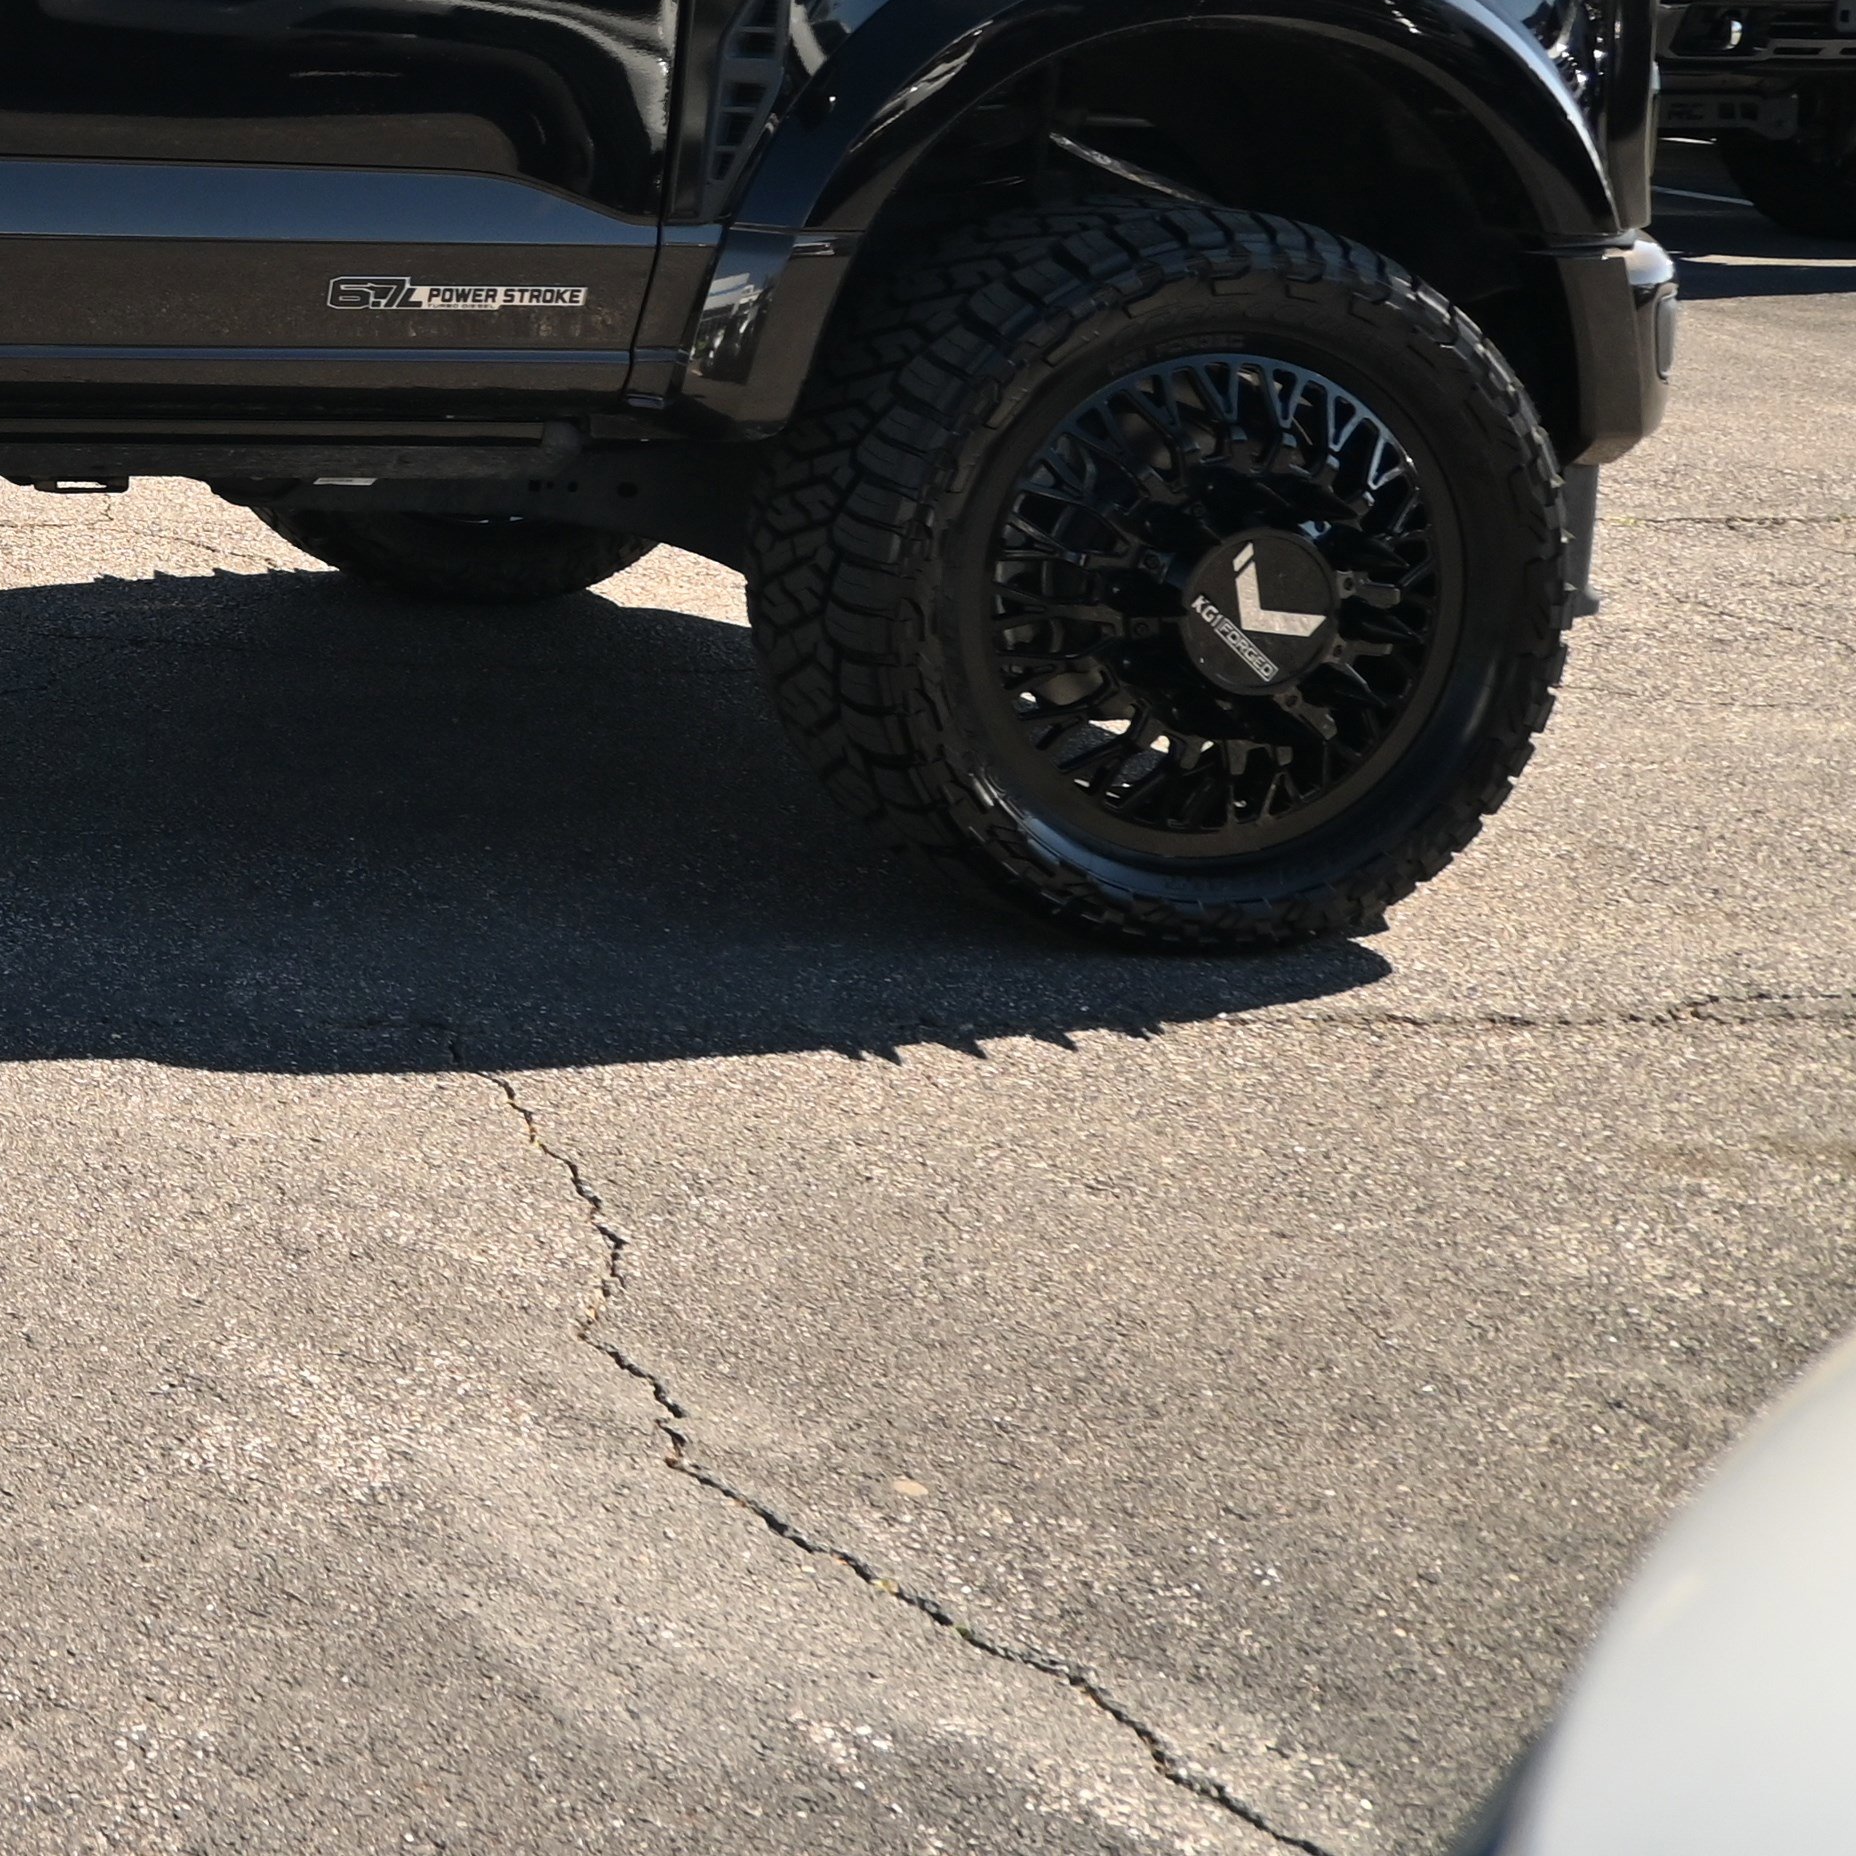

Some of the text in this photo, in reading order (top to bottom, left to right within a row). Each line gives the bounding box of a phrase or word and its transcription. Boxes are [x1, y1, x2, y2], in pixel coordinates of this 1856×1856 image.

[427, 287, 498, 303] POWER
[502, 288, 582, 305] STROKE
[1190, 595, 1276, 679] KG1 FORGED
